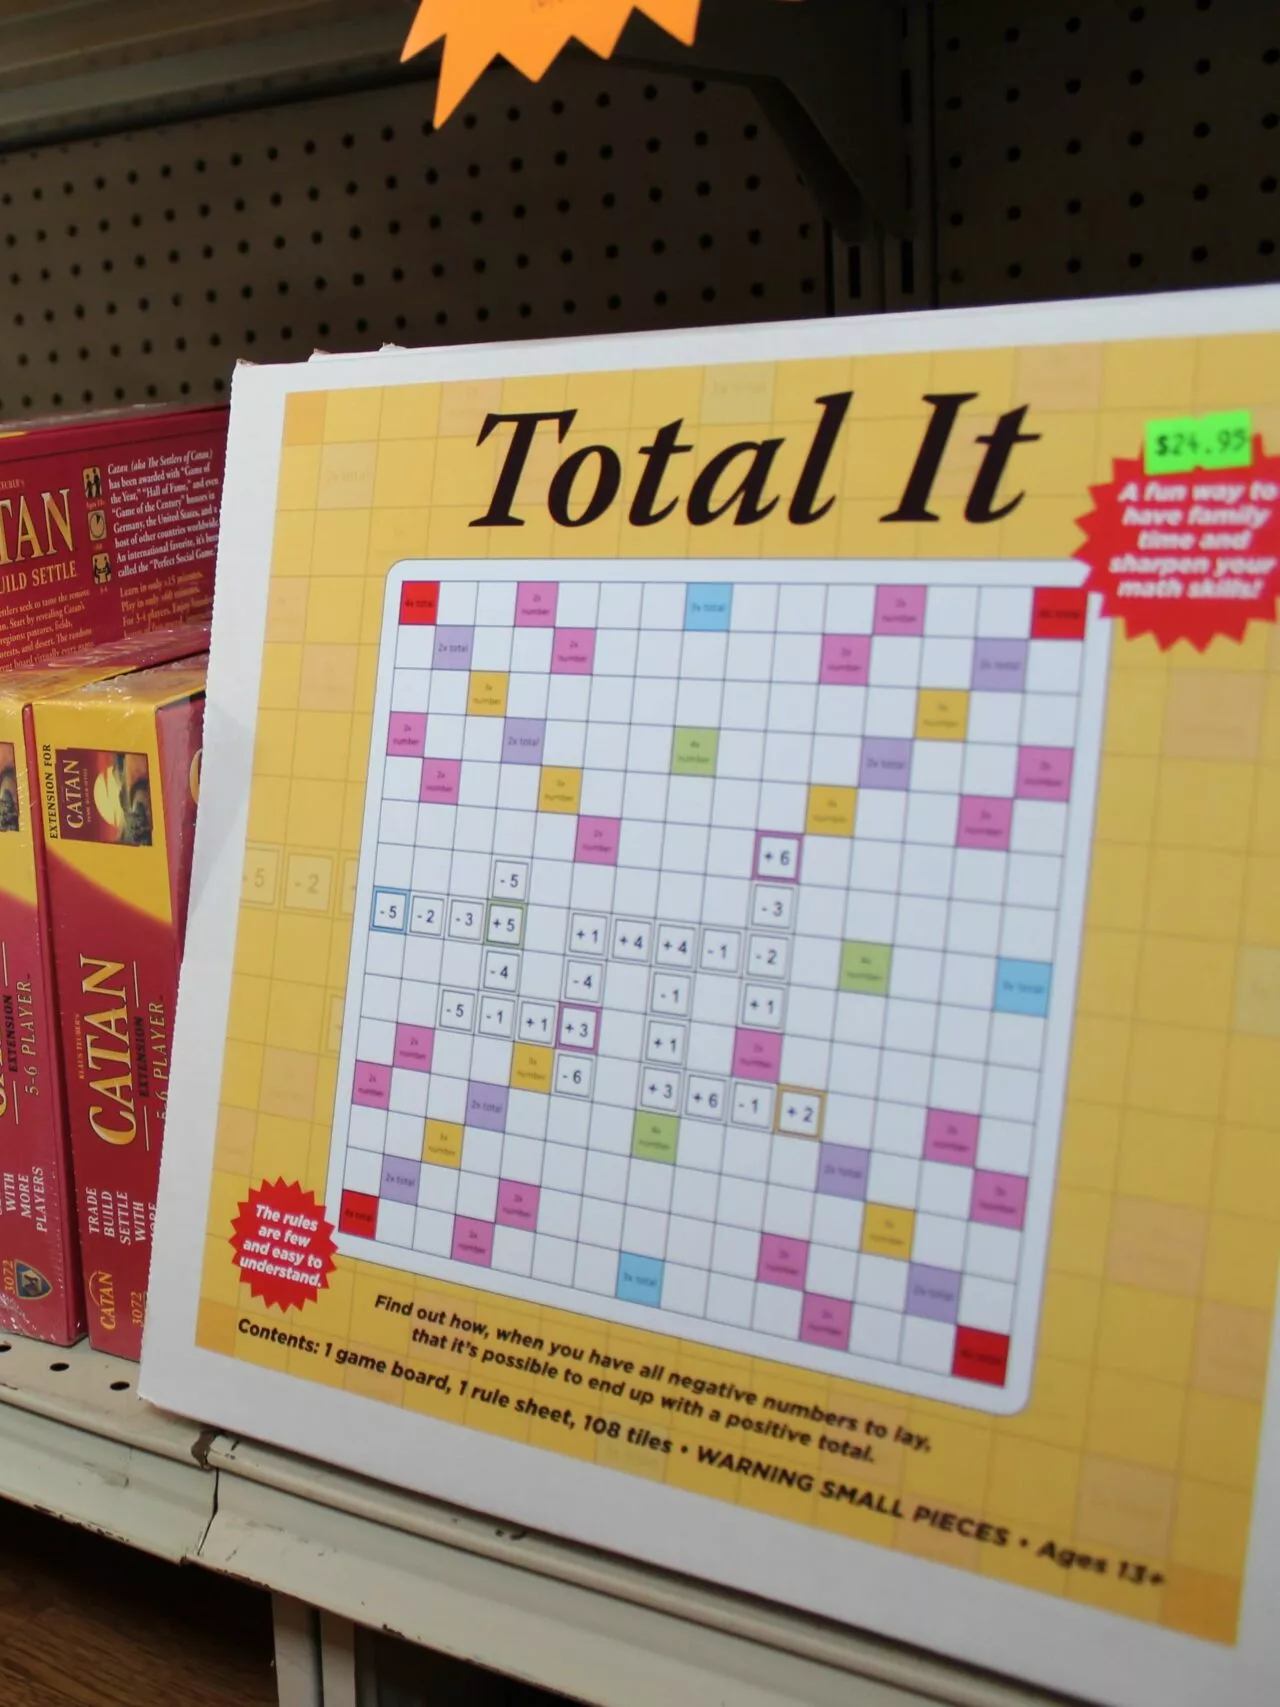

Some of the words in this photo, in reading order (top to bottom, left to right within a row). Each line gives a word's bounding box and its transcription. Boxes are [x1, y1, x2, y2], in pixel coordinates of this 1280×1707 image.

[468, 390, 854, 527] Total
[878, 391, 1043, 524] It
[1155, 429, 1246, 457] $24.95
[31, 560, 77, 586] SETTLE
[43, 744, 52, 769] FOR
[47, 772, 58, 839] EXTENSION
[63, 760, 85, 829] CATAN
[3, 994, 18, 1073] EXTENSION
[17, 980, 36, 1057] PLAYER
[148, 1001, 169, 1081] PLAYER
[79, 953, 138, 1146] CATAN
[134, 1016, 150, 1098] EXTENSION
[24, 1065, 39, 1096] 5-6
[3, 1171, 17, 1212] WITH
[18, 1173, 32, 1219] MORE
[31, 1166, 48, 1234] PLAYERS
[85, 1186, 100, 1235] TRADE
[100, 1189, 115, 1238] BUILD
[113, 1191, 131, 1246] SETTLE
[131, 1201, 146, 1242] WITH
[255, 1203, 281, 1222] The
[282, 1212, 318, 1232] rules
[258, 1225, 281, 1240] are
[283, 1229, 312, 1248] few
[1, 1259, 16, 1295] 3072
[239, 1256, 322, 1288] understand.
[243, 1238, 269, 1255] and
[271, 1246, 305, 1265] easy
[306, 1252, 323, 1269] to
[99, 1270, 116, 1331] CATAN
[132, 1291, 146, 1327] 3072
[374, 1294, 414, 1317] Find
[416, 1306, 446, 1325] out
[449, 1314, 490, 1339] how,
[496, 1327, 544, 1351] when
[549, 1338, 584, 1361] you
[588, 1349, 634, 1374] have
[639, 1364, 665, 1381] all
[668, 1372, 758, 1406] negative
[763, 1396, 859, 1432] numbers
[864, 1418, 888, 1439] to
[893, 1425, 932, 1453] lay,
[411, 1327, 447, 1350] that
[450, 1337, 478, 1358] it's
[481, 1348, 558, 1379] possible
[563, 1367, 584, 1386] to
[588, 1376, 626, 1397] end
[629, 1386, 654, 1407] up
[660, 1394, 704, 1419] with
[708, 1407, 721, 1423] a
[724, 1411, 812, 1447] positive
[817, 1434, 875, 1464] total.
[237, 1318, 321, 1355] Contents:
[324, 1342, 333, 1358] 1
[335, 1348, 387, 1373] game
[391, 1360, 451, 1394] board,
[458, 1379, 468, 1396] 1
[470, 1385, 510, 1408] rule
[514, 1399, 576, 1429] sheet,
[582, 1414, 621, 1440] 108
[627, 1428, 673, 1454] tiles
[695, 1445, 816, 1494] WARNING
[818, 1480, 904, 1519] SMALL
[912, 1504, 1010, 1547] PIECES
[1035, 1539, 1108, 1575] Ages
[1116, 1560, 1166, 1587] 13+
